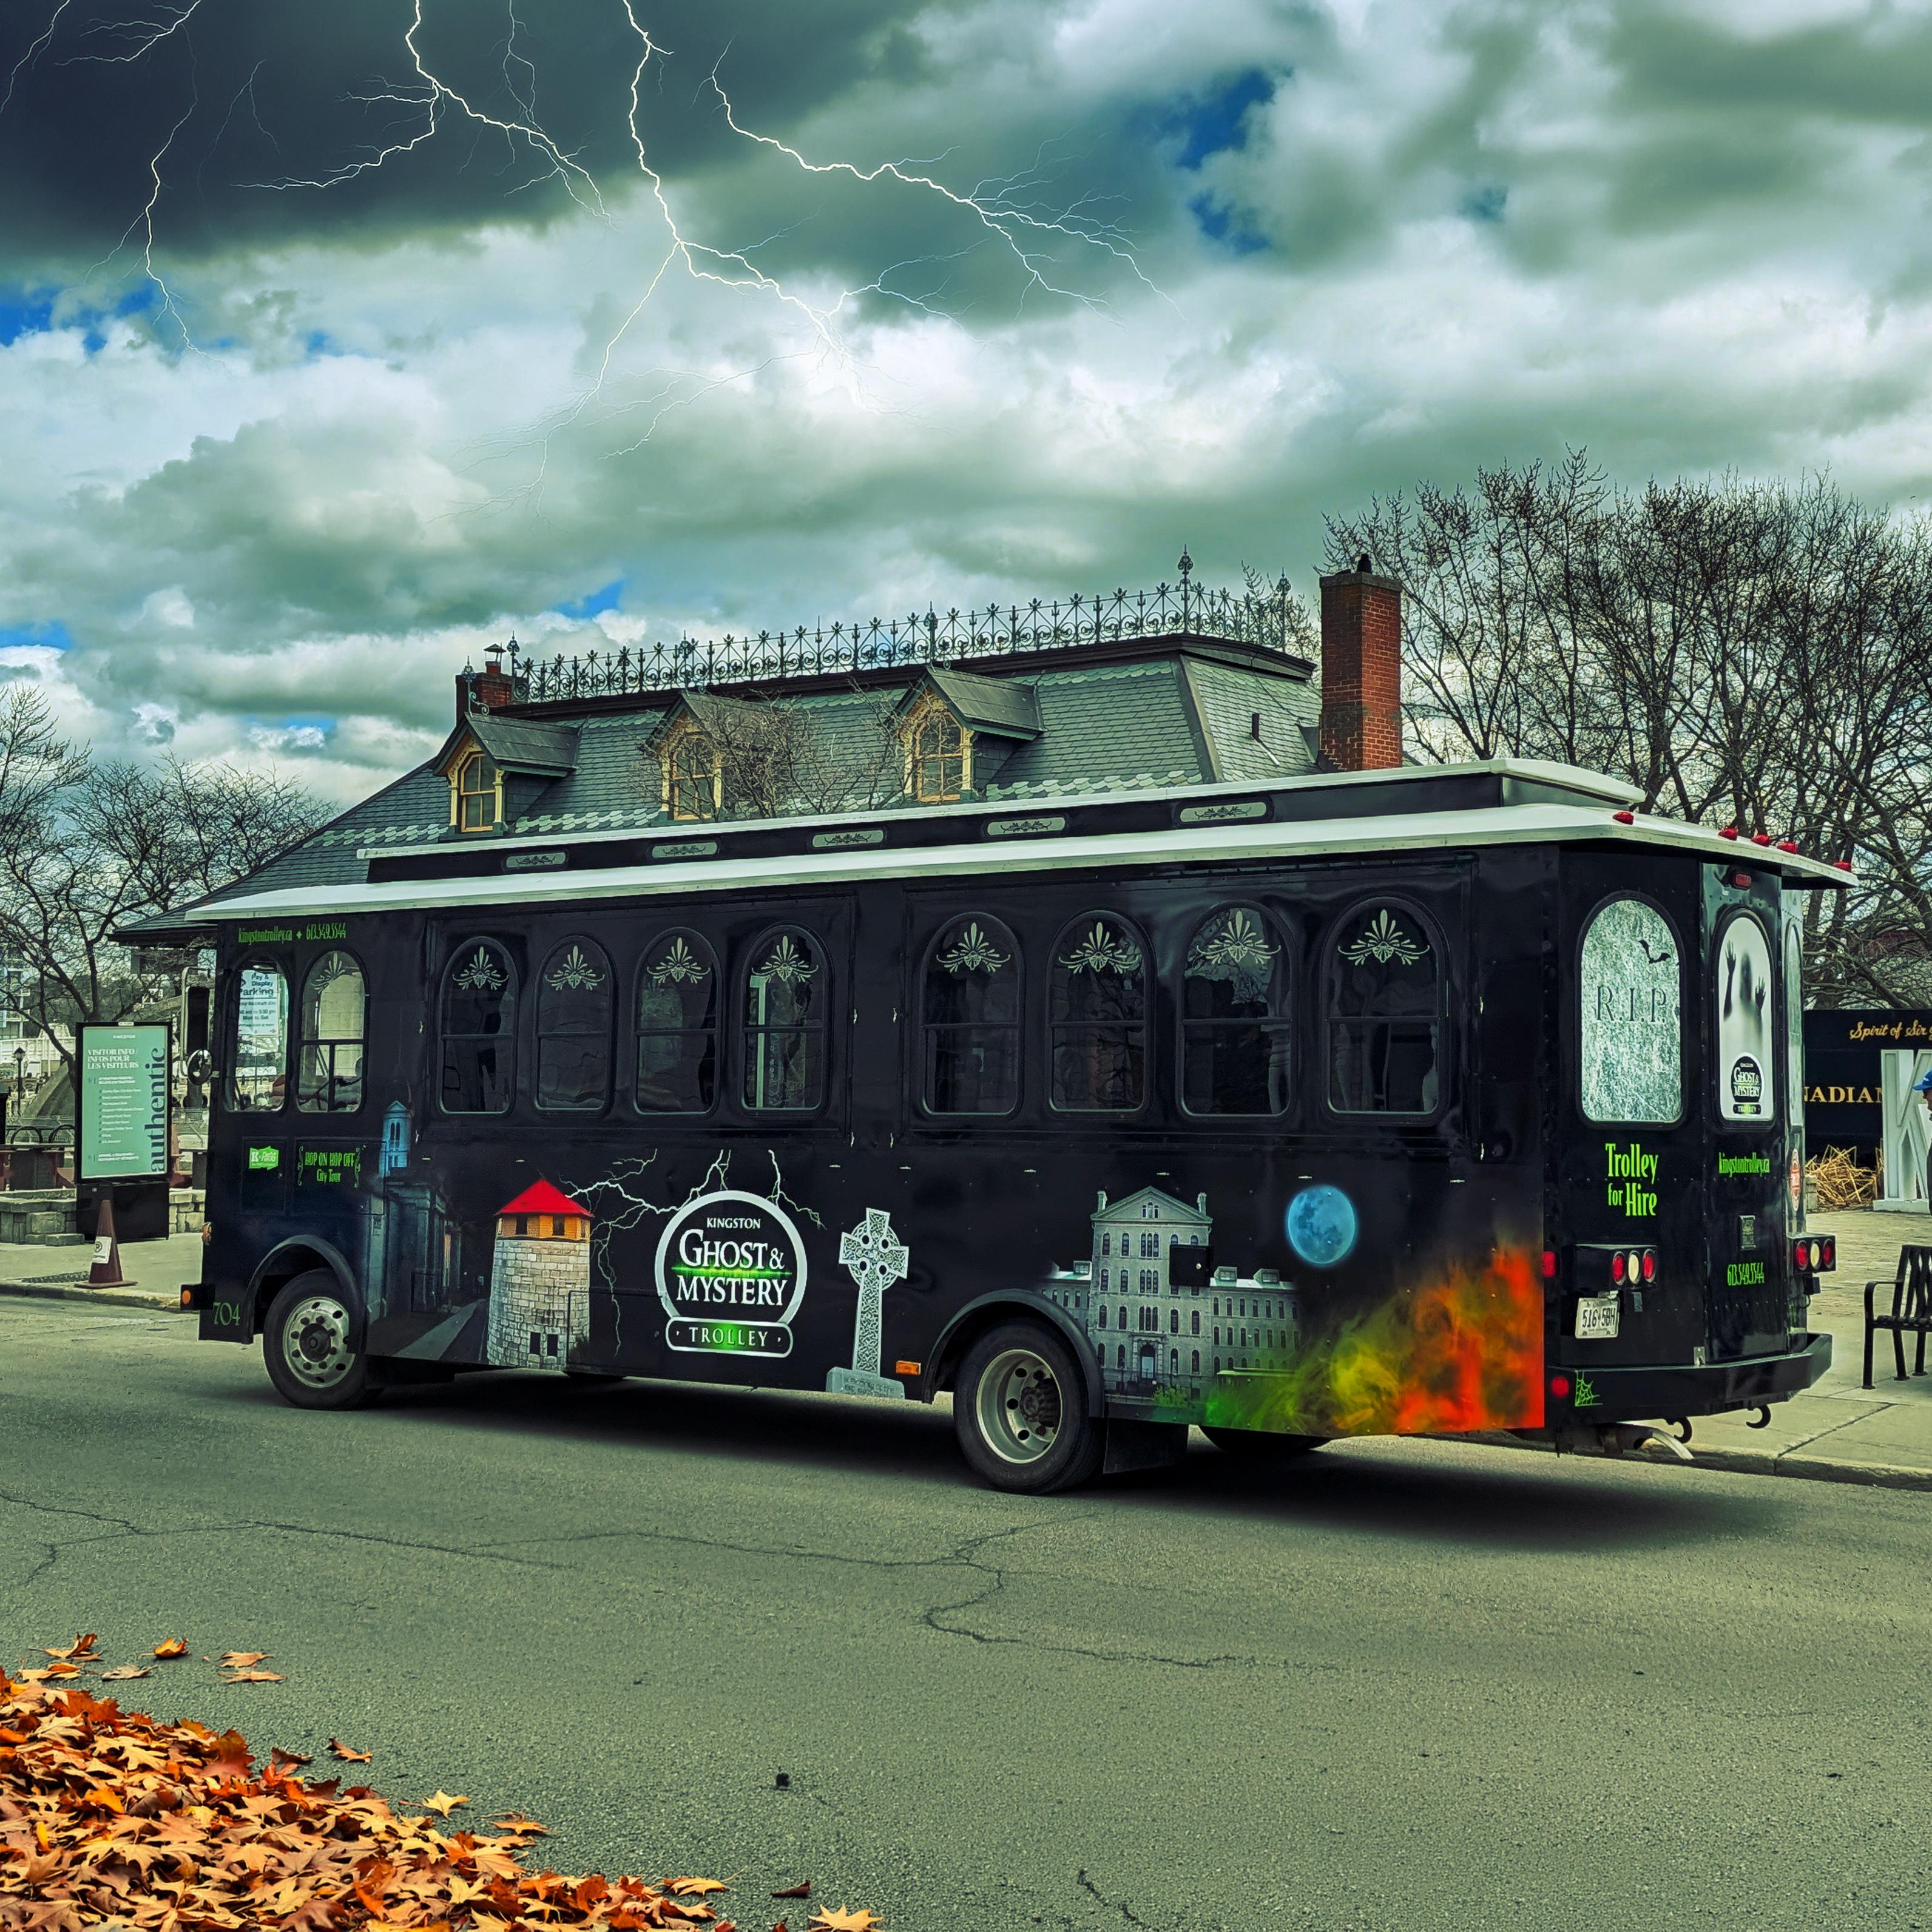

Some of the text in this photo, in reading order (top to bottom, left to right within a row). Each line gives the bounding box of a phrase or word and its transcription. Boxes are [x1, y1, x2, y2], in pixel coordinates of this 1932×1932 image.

[241, 987, 274, 997] arking
[1849, 1021, 1888, 1041] Spirit
[1890, 1022, 1902, 1039] of
[1904, 1019, 1927, 1037] Sir
[1734, 1067, 1755, 1083] GHOST
[1734, 1086, 1760, 1097] MYSTERY
[144, 1047, 165, 1172] authentic
[305, 1152, 355, 1167] HOP ON HOP OFF
[1605, 1143, 1658, 1184] Trolley
[1719, 1152, 1770, 1177] kingstontrolley.ca
[317, 1169, 341, 1183] City Tour
[1608, 1183, 1657, 1216] for Hire
[706, 1217, 761, 1229] KINGSTON
[679, 1229, 785, 1269] GHOST &
[676, 1275, 788, 1306] MYSTERY
[213, 1302, 240, 1326] 704
[689, 1327, 768, 1346] TROLLEY
